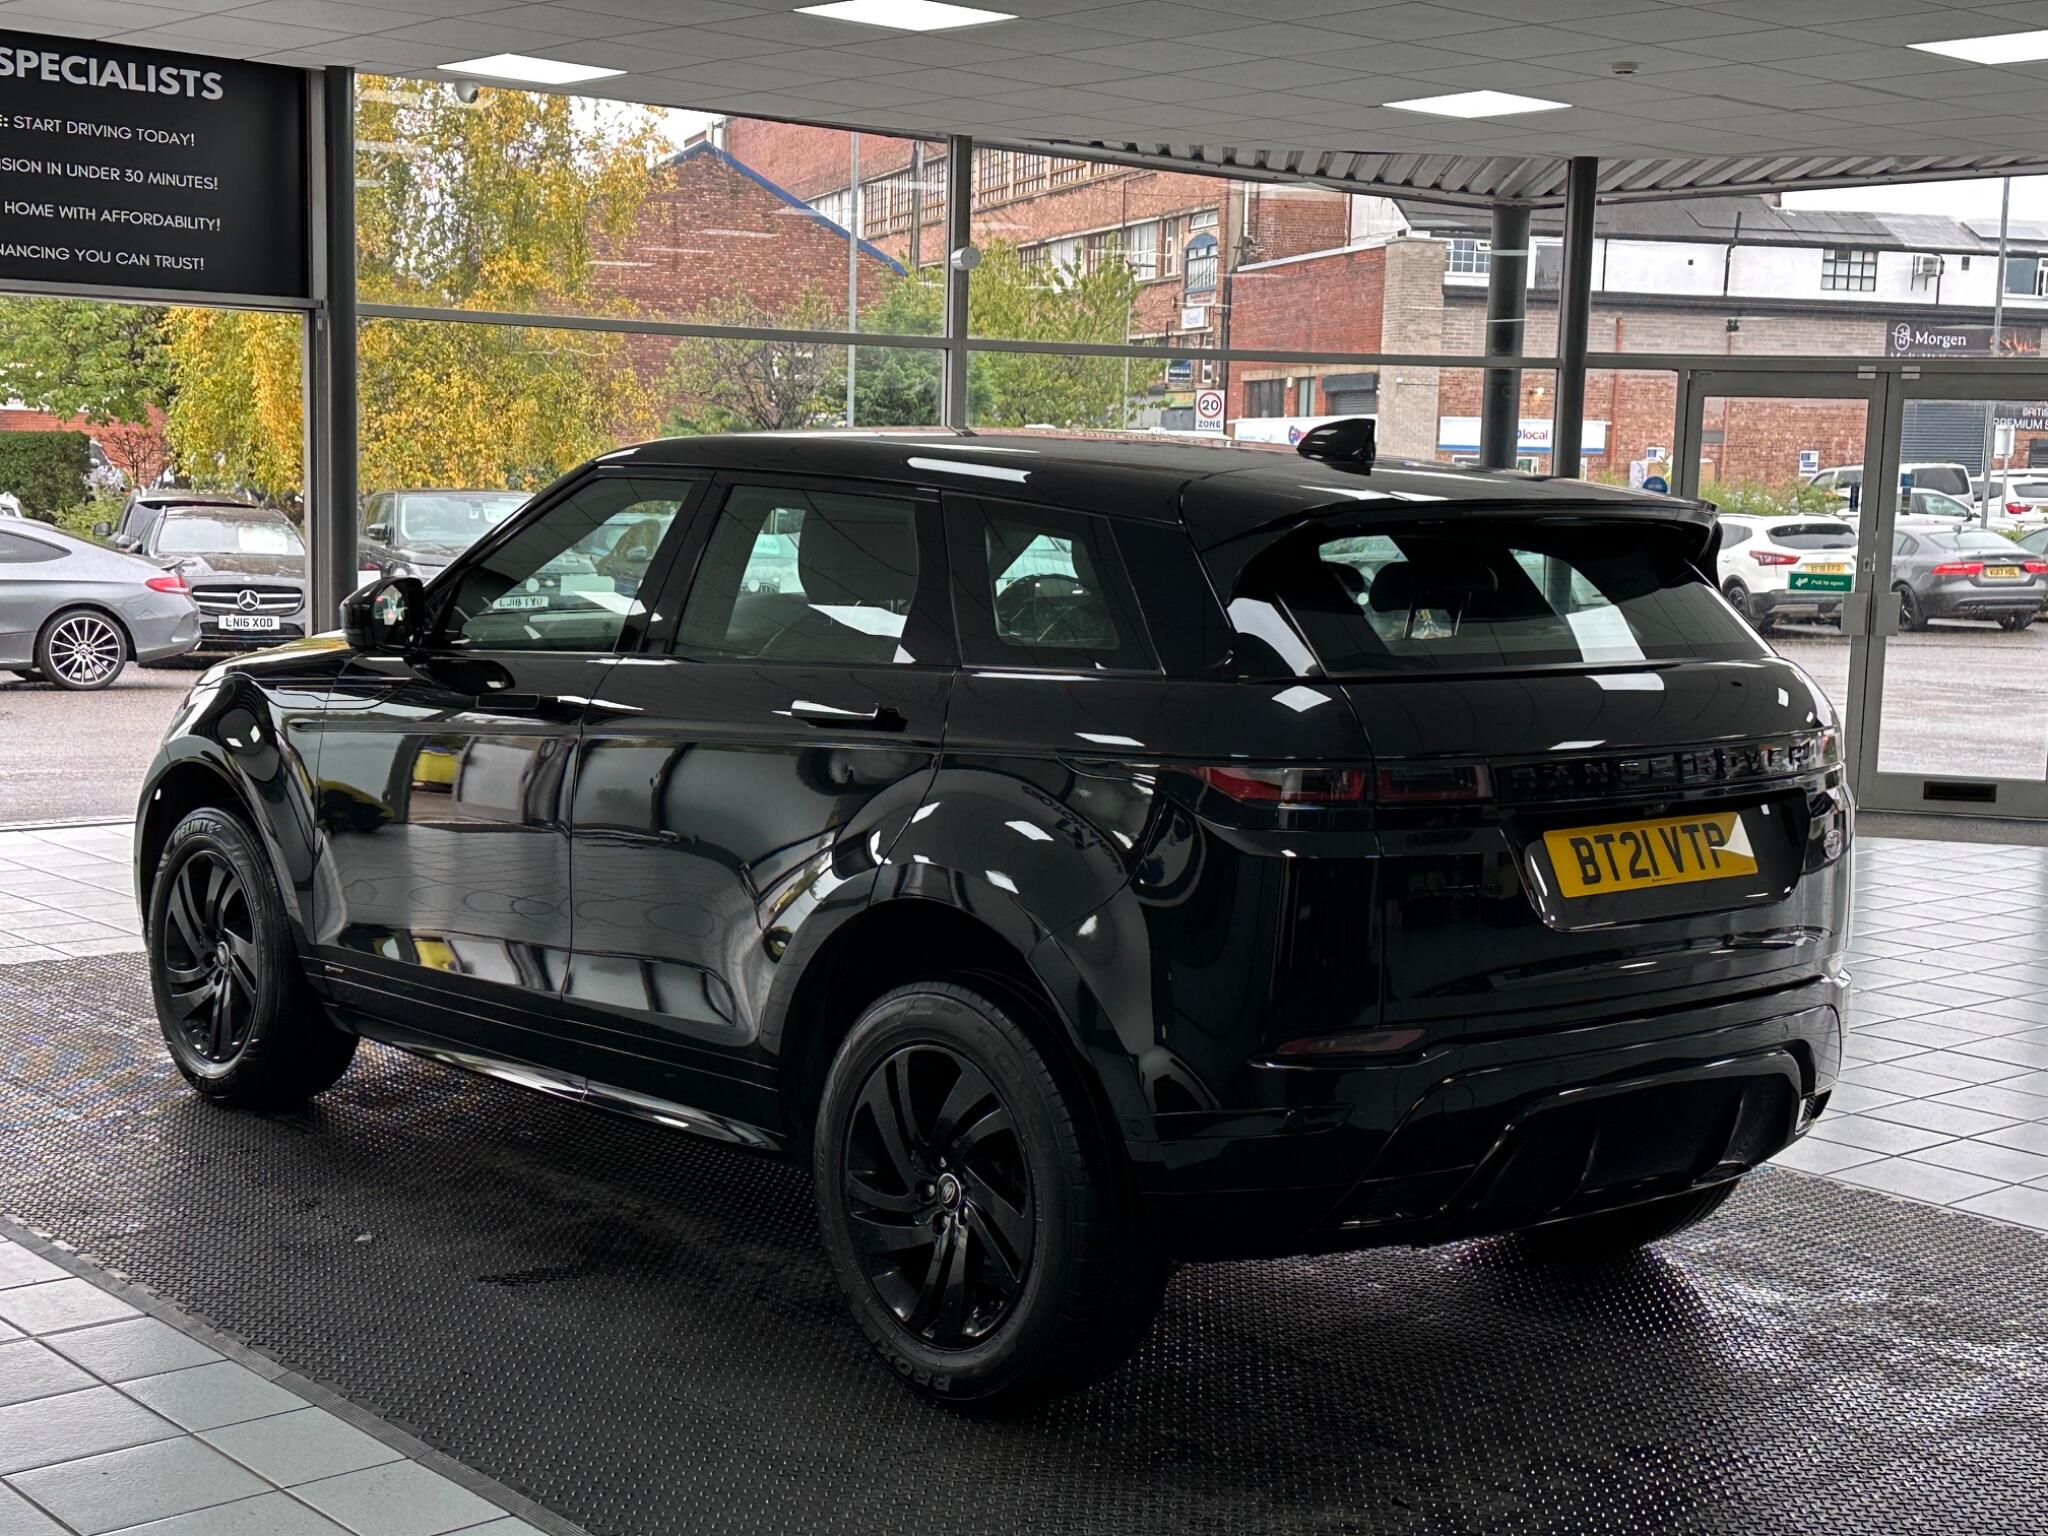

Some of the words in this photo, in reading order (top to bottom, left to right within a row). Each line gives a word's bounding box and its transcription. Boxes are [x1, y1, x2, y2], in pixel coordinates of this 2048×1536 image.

[0, 46, 224, 100] SPECIALISTS
[13, 115, 63, 133] START
[66, 121, 132, 140] DRIVING
[136, 129, 195, 146] TODAY!
[47, 162, 62, 176] IN
[66, 164, 120, 181] UNDER
[124, 169, 144, 183] 30
[148, 172, 219, 190] MINUTES!
[4, 201, 54, 217] HOME
[59, 206, 96, 221] WITH
[100, 209, 221, 232] AFFORDABILITY!
[74, 249, 111, 264] YOU
[115, 251, 150, 266] CAN
[154, 254, 205, 270] TRUST!
[1915, 331, 1967, 348] Morgen
[1202, 399, 1219, 411] 20
[1198, 420, 1221, 429] ZONE
[225, 617, 250, 627] LN16
[252, 617, 273, 627] XOD
[1569, 829, 1661, 886] BT21
[1657, 822, 1726, 874] VTP
